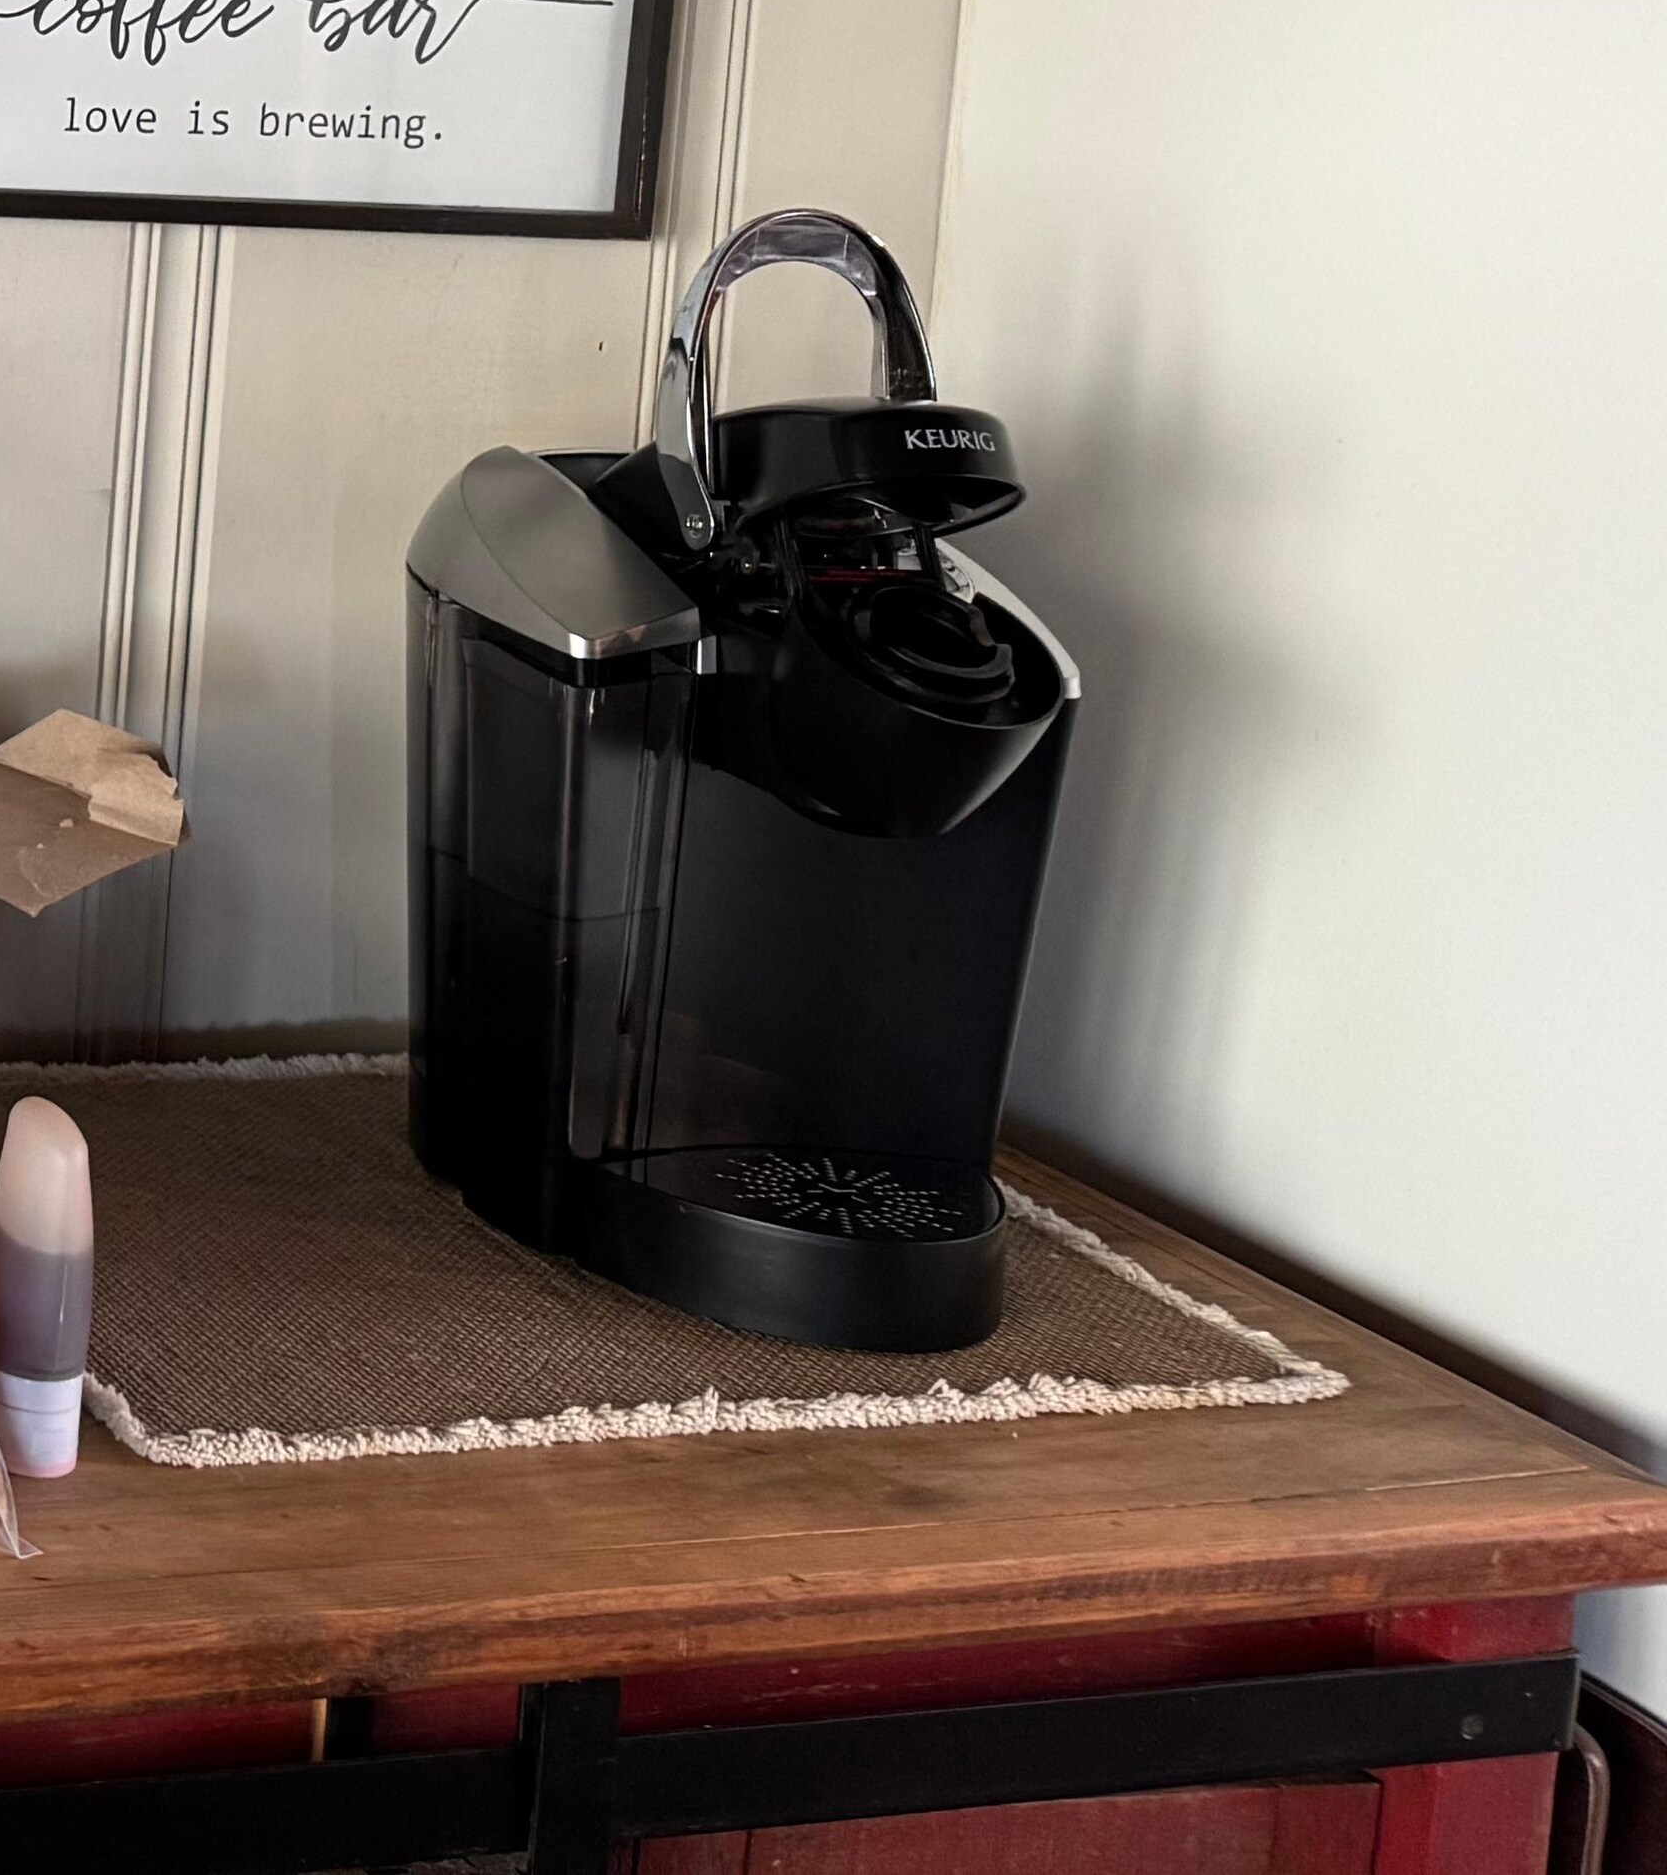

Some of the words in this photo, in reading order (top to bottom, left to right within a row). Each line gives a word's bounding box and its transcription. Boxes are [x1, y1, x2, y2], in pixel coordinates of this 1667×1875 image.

[64, 97, 157, 135] love
[188, 101, 230, 136] is
[260, 104, 444, 151] brewing.
[904, 428, 996, 452] KEURIG
